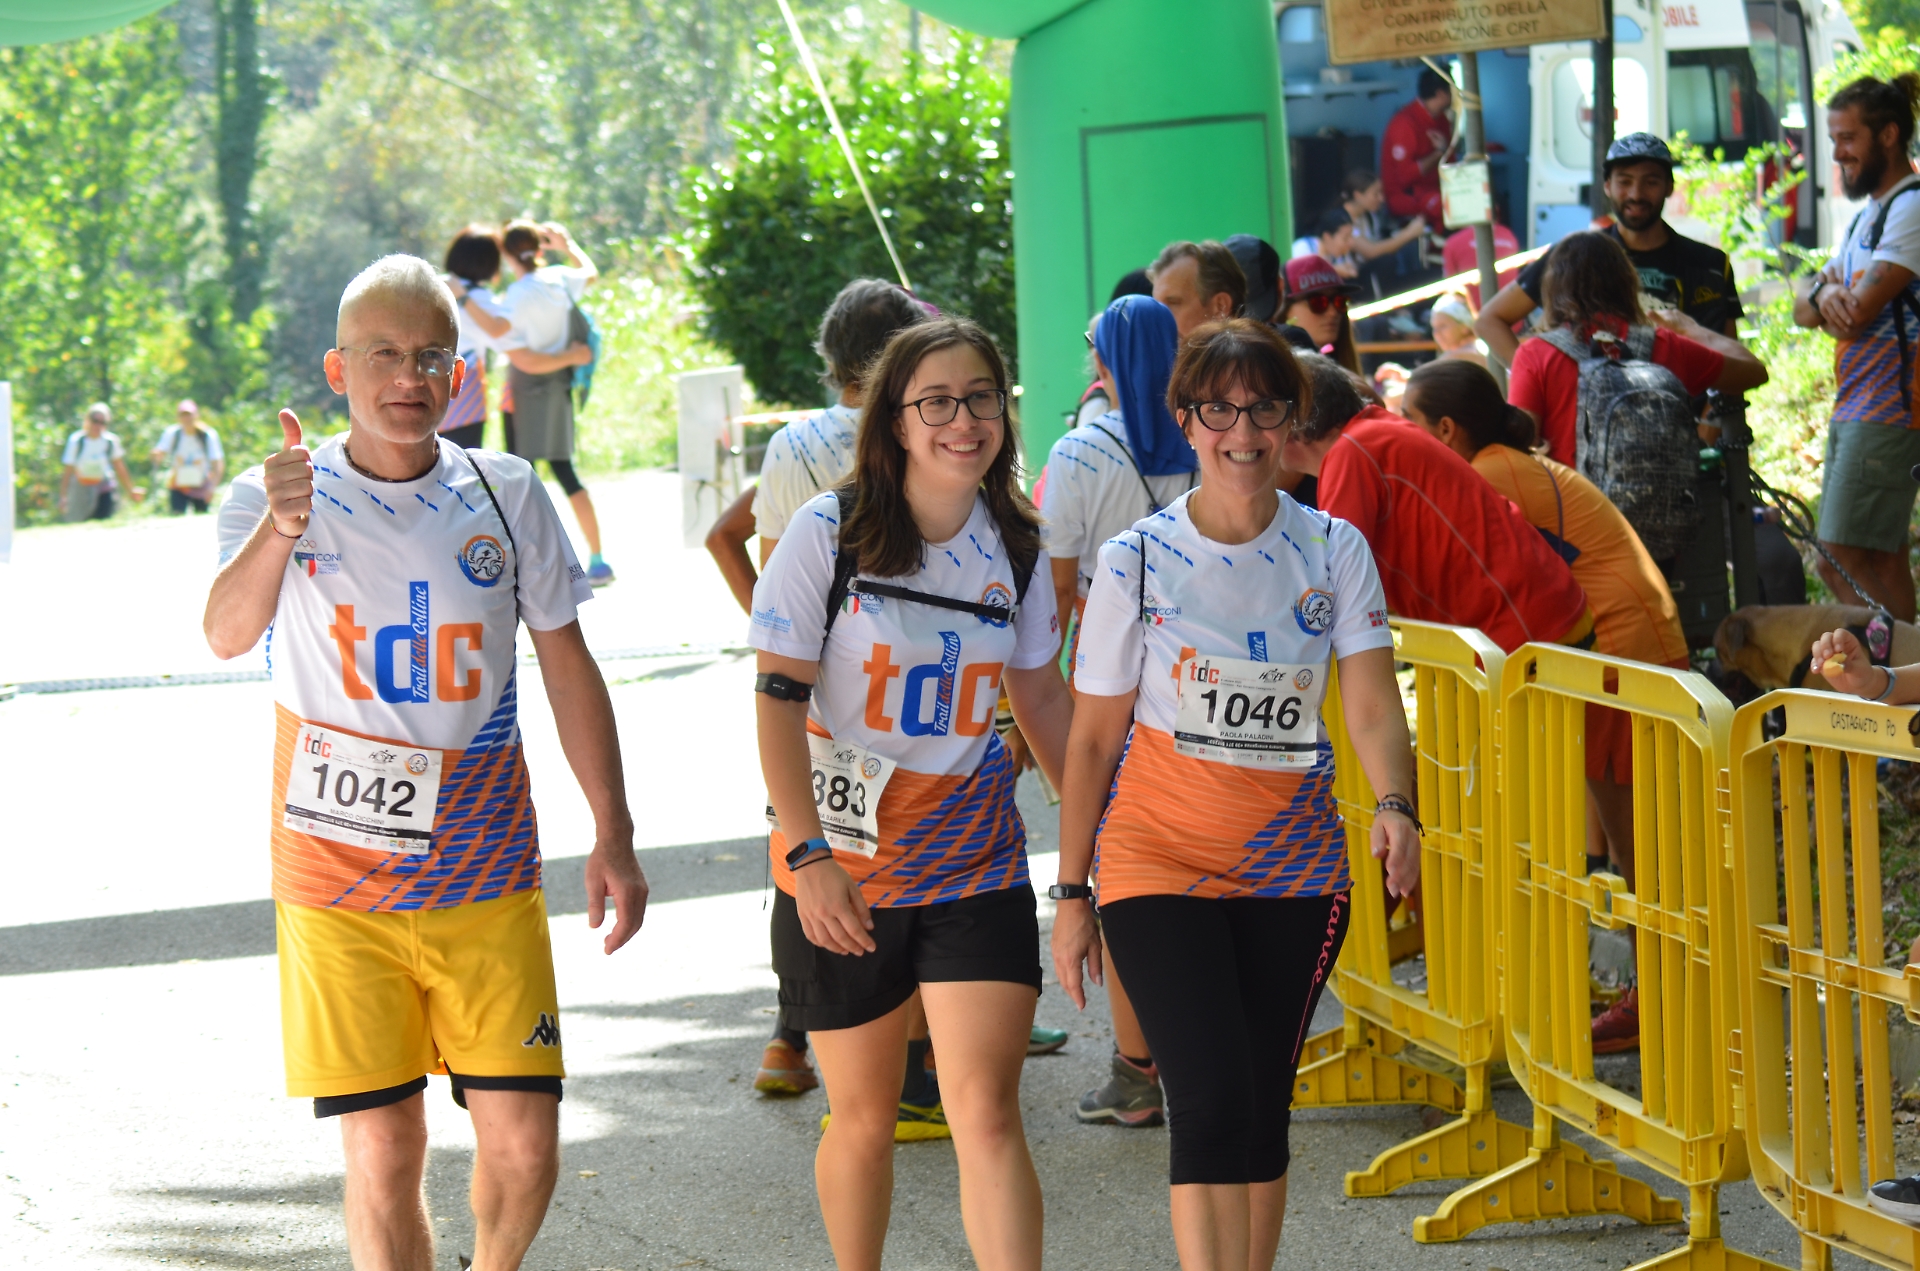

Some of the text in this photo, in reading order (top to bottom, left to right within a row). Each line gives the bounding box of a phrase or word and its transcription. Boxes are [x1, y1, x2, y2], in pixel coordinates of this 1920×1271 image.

[1383, 0, 1548, 28] CONTRIBUTO DELLA
[1395, 20, 1540, 46] FONDAZIONE CRT
[315, 553, 342, 562] CONI
[1158, 607, 1181, 615] CONI
[1190, 660, 1220, 685] tdc
[1201, 689, 1302, 731] 1046
[1831, 711, 1878, 733] CASTAGNETO
[304, 733, 332, 759] tdc
[1220, 731, 1274, 741] PAOLA PALADINI
[312, 762, 417, 818] 1042
[329, 808, 354, 820] MARCO
